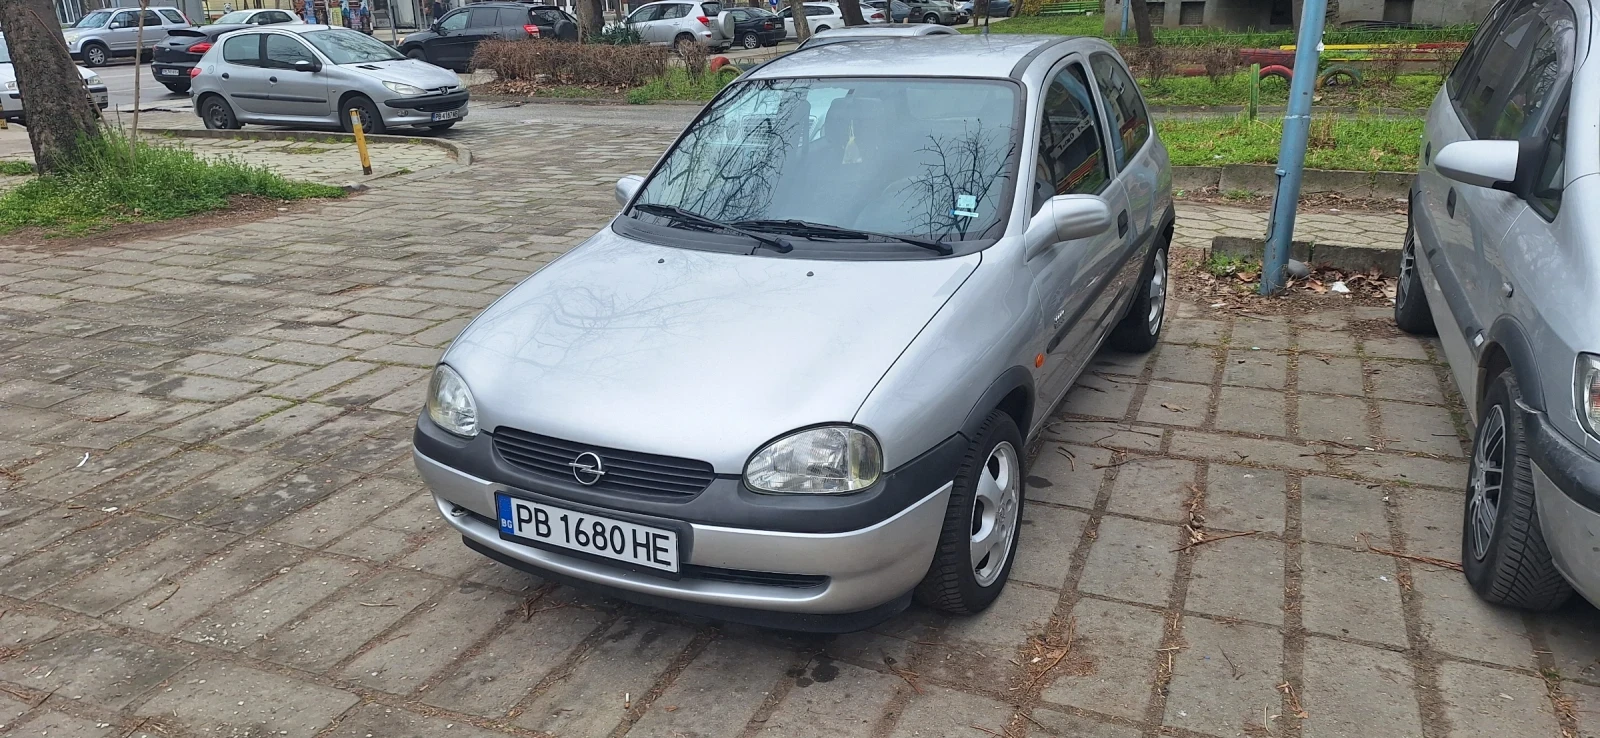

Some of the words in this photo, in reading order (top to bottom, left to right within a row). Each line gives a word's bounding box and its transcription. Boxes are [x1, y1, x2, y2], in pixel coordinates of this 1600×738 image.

[501, 519, 513, 529] BG
[516, 504, 551, 538] PB
[560, 514, 626, 555] 1680
[632, 529, 672, 566] HE
